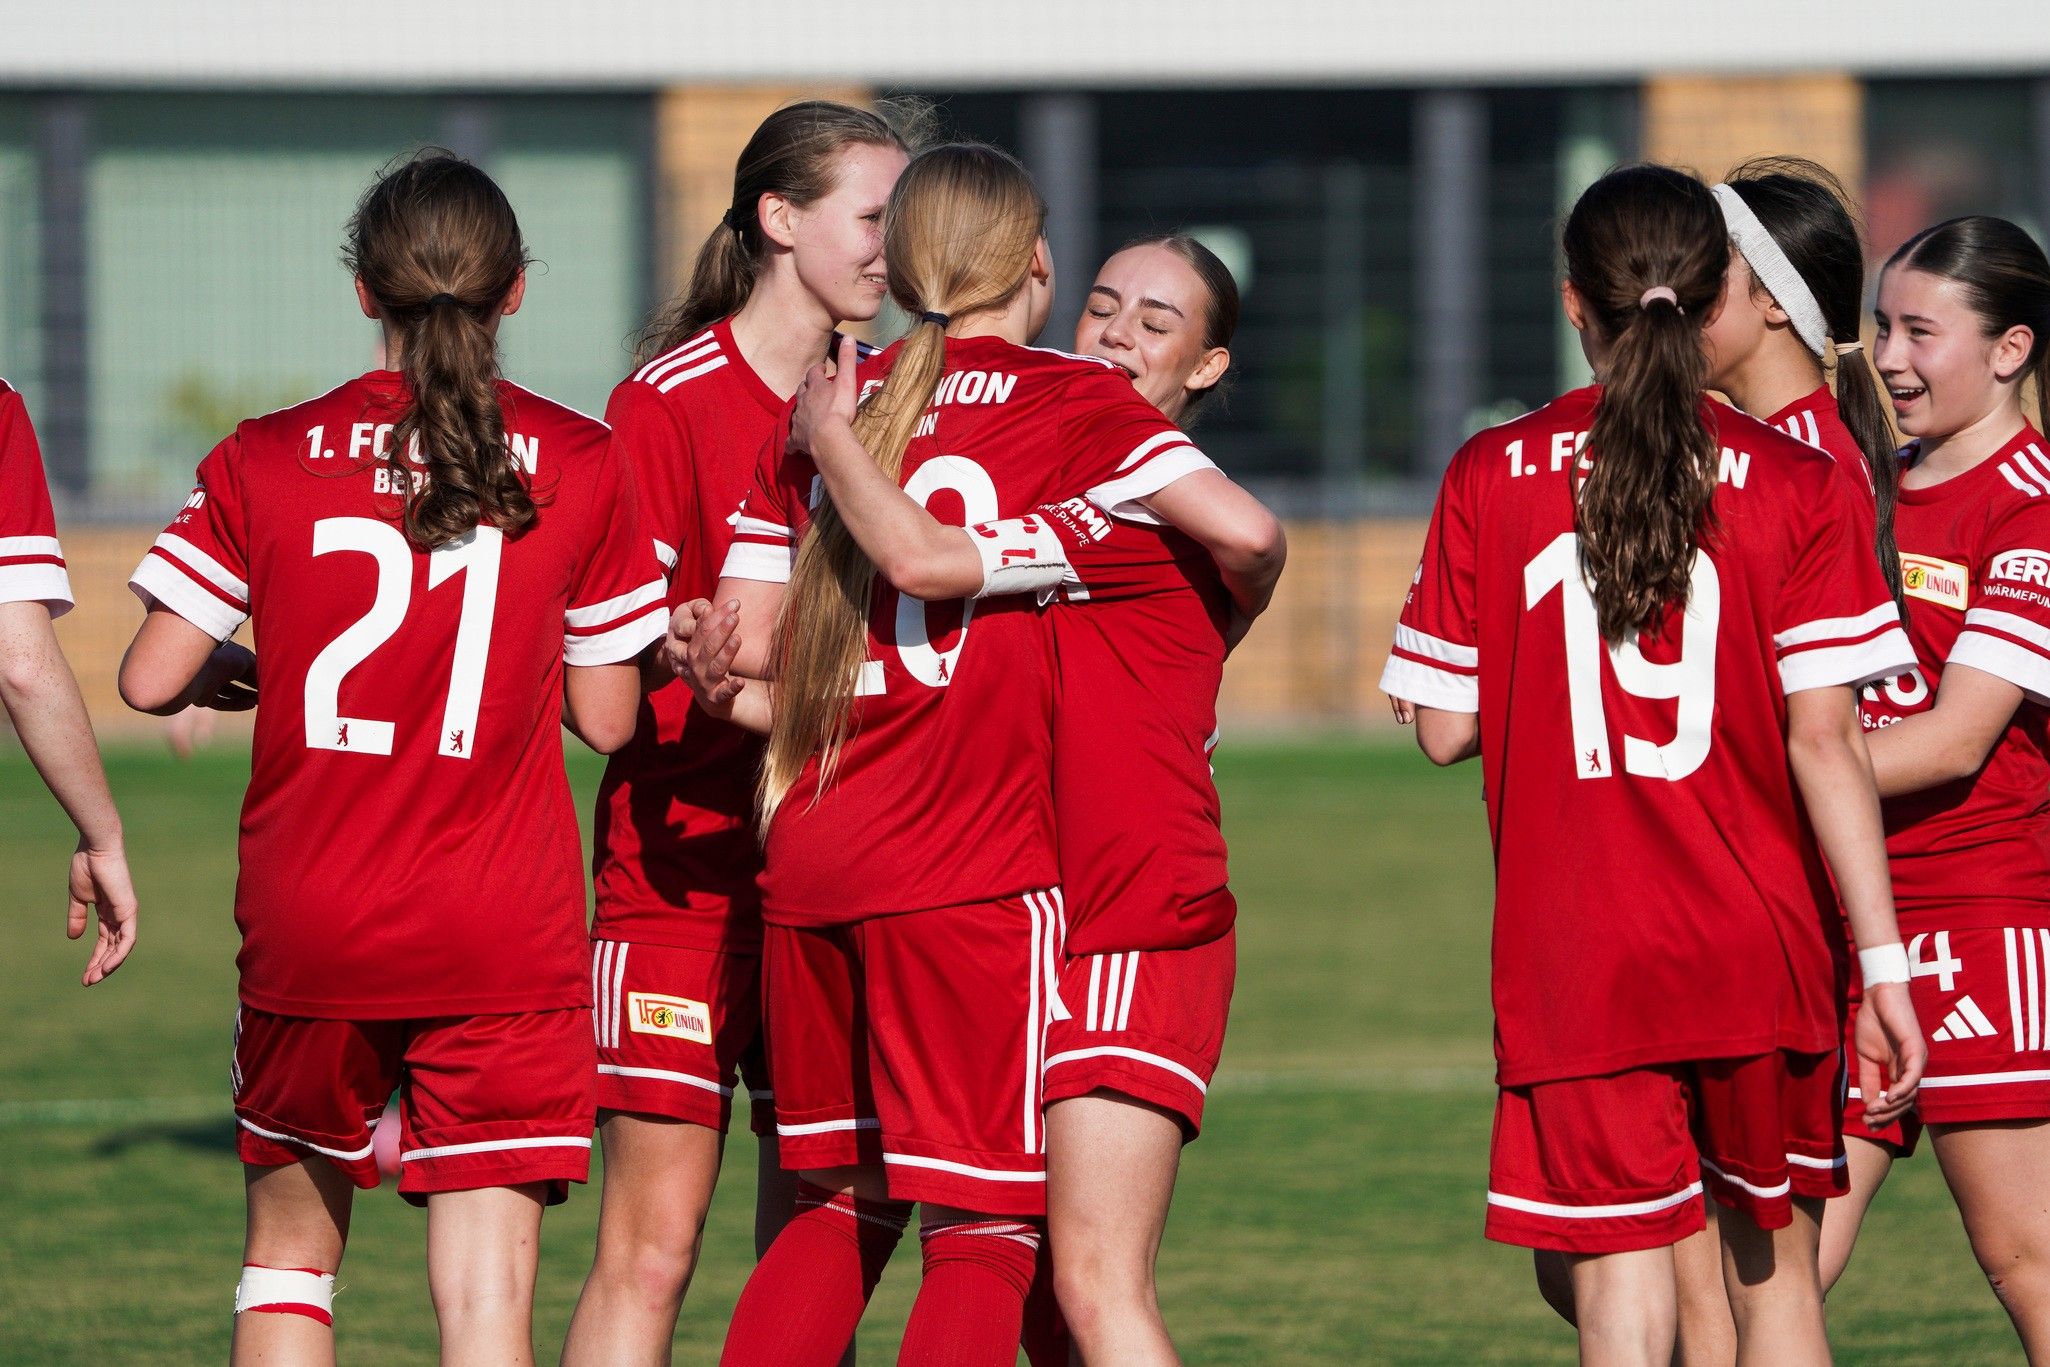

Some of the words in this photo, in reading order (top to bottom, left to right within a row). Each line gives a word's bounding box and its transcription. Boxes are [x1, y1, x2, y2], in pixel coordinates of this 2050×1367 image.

[305, 424, 335, 459] 1.
[348, 422, 398, 461] FC
[1505, 440, 1537, 478] 1.
[1060, 497, 1112, 542] RMI
[1926, 574, 1960, 597] UNION
[1988, 548, 2050, 589] KER
[304, 516, 503, 759] 21
[1524, 532, 1721, 782] 19
[674, 1013, 705, 1033] UNION
